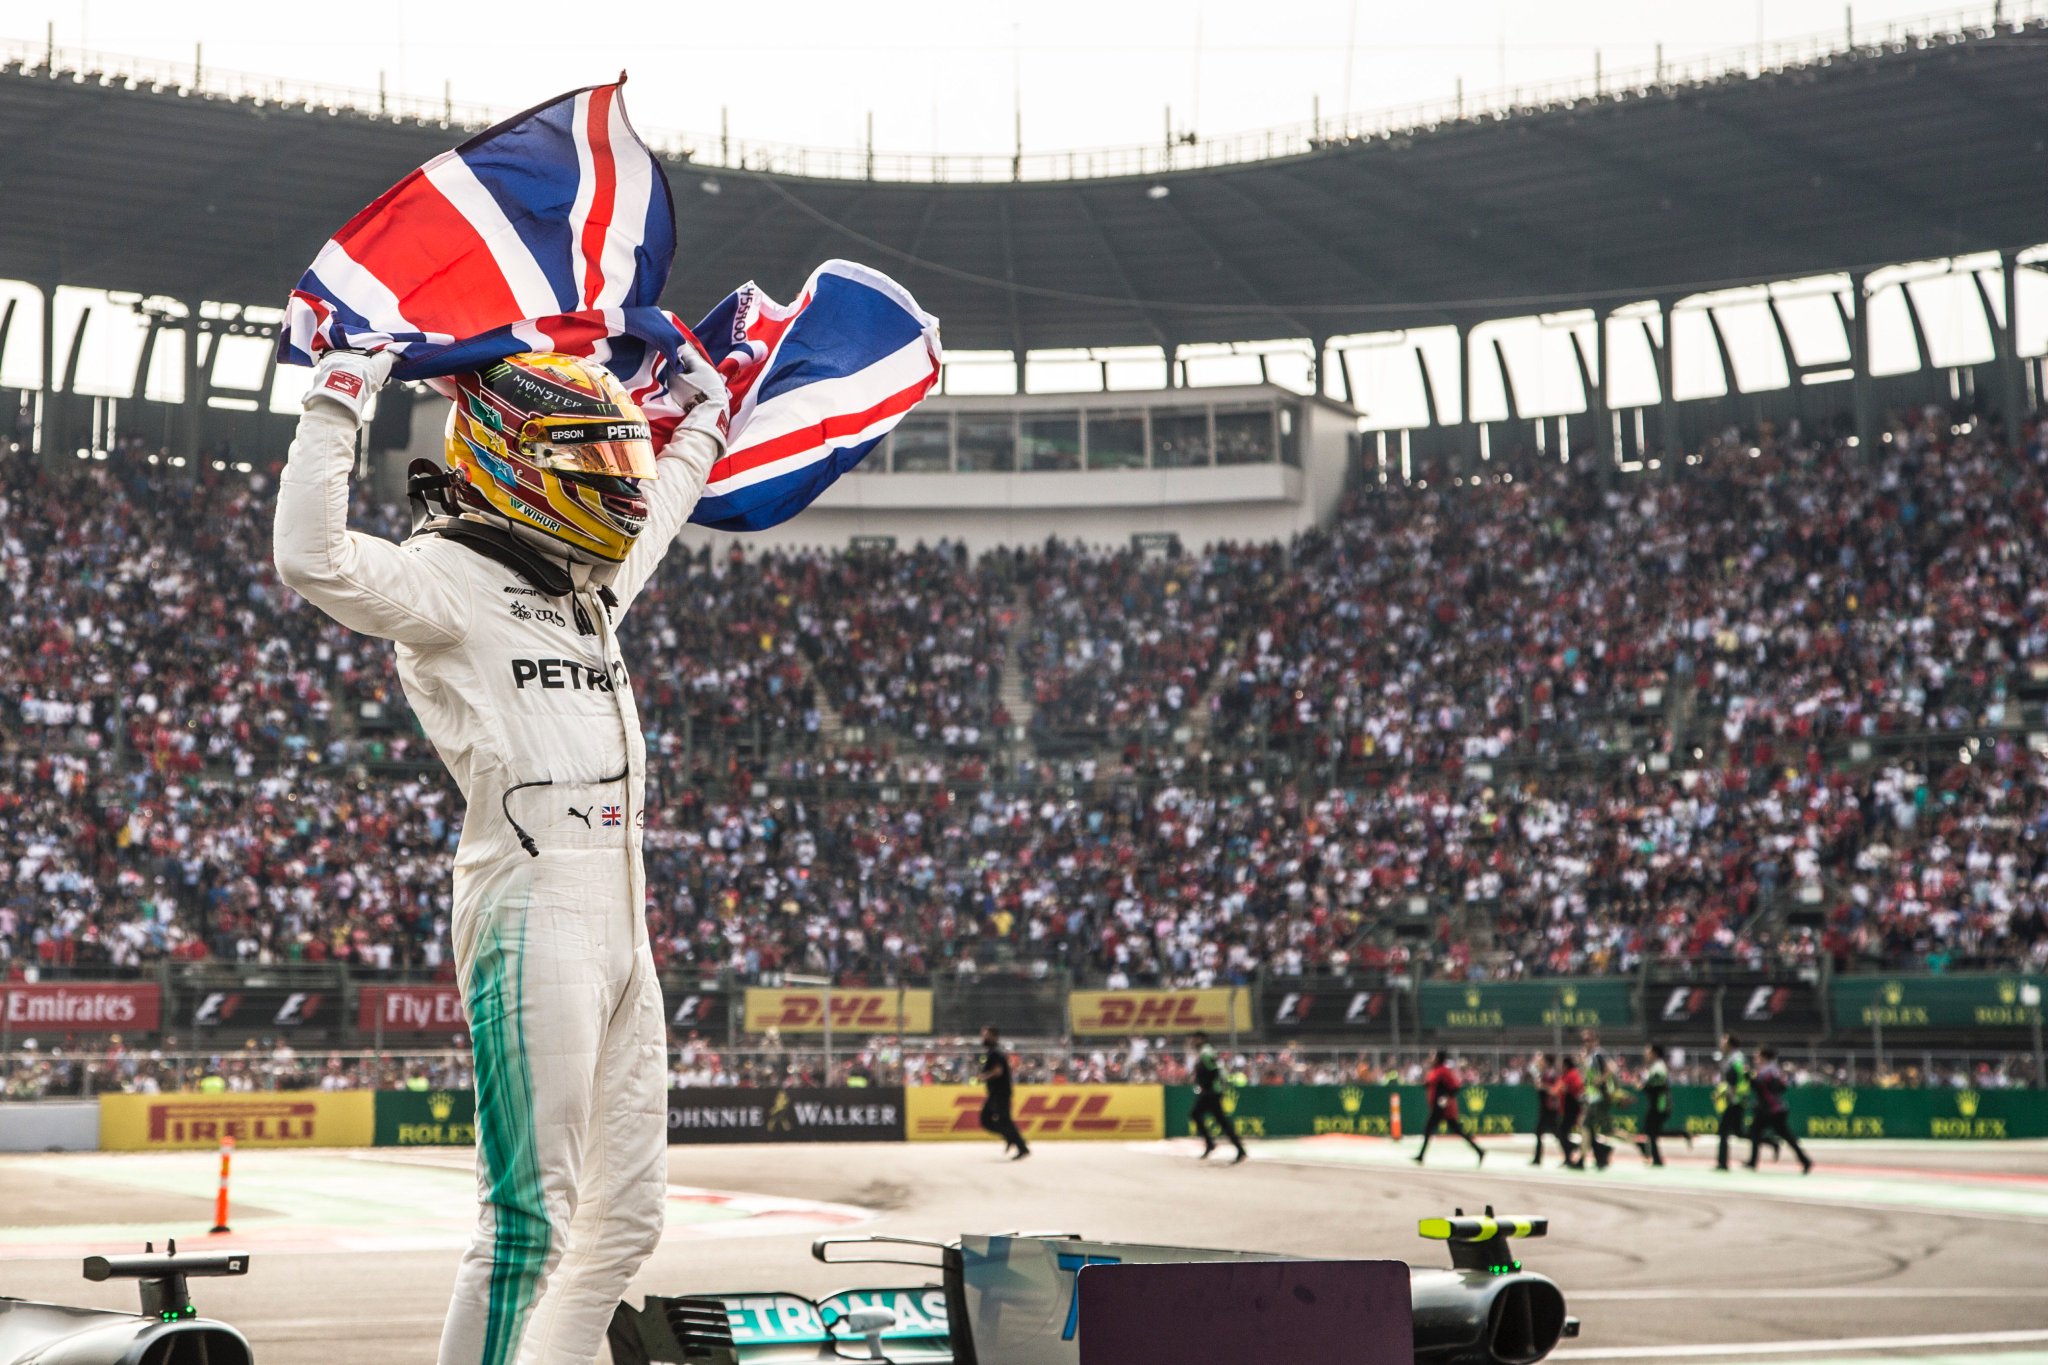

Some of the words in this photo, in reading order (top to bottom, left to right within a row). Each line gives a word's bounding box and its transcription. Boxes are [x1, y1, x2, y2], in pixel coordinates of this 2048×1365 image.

[551, 430, 584, 440] EPSON
[523, 505, 561, 532] WIHURI
[8, 989, 136, 1022] Emirates
[387, 992, 432, 1027] Fly
[779, 997, 888, 1025] DHL
[1099, 997, 1204, 1026] DHL
[1447, 1010, 1502, 1026] ROLEX
[1862, 1006, 1929, 1026] ROLEX
[149, 1102, 315, 1142] PIRELLI
[1807, 1116, 1883, 1137] ROLEX
[1930, 1117, 2006, 1138] ROLEX
